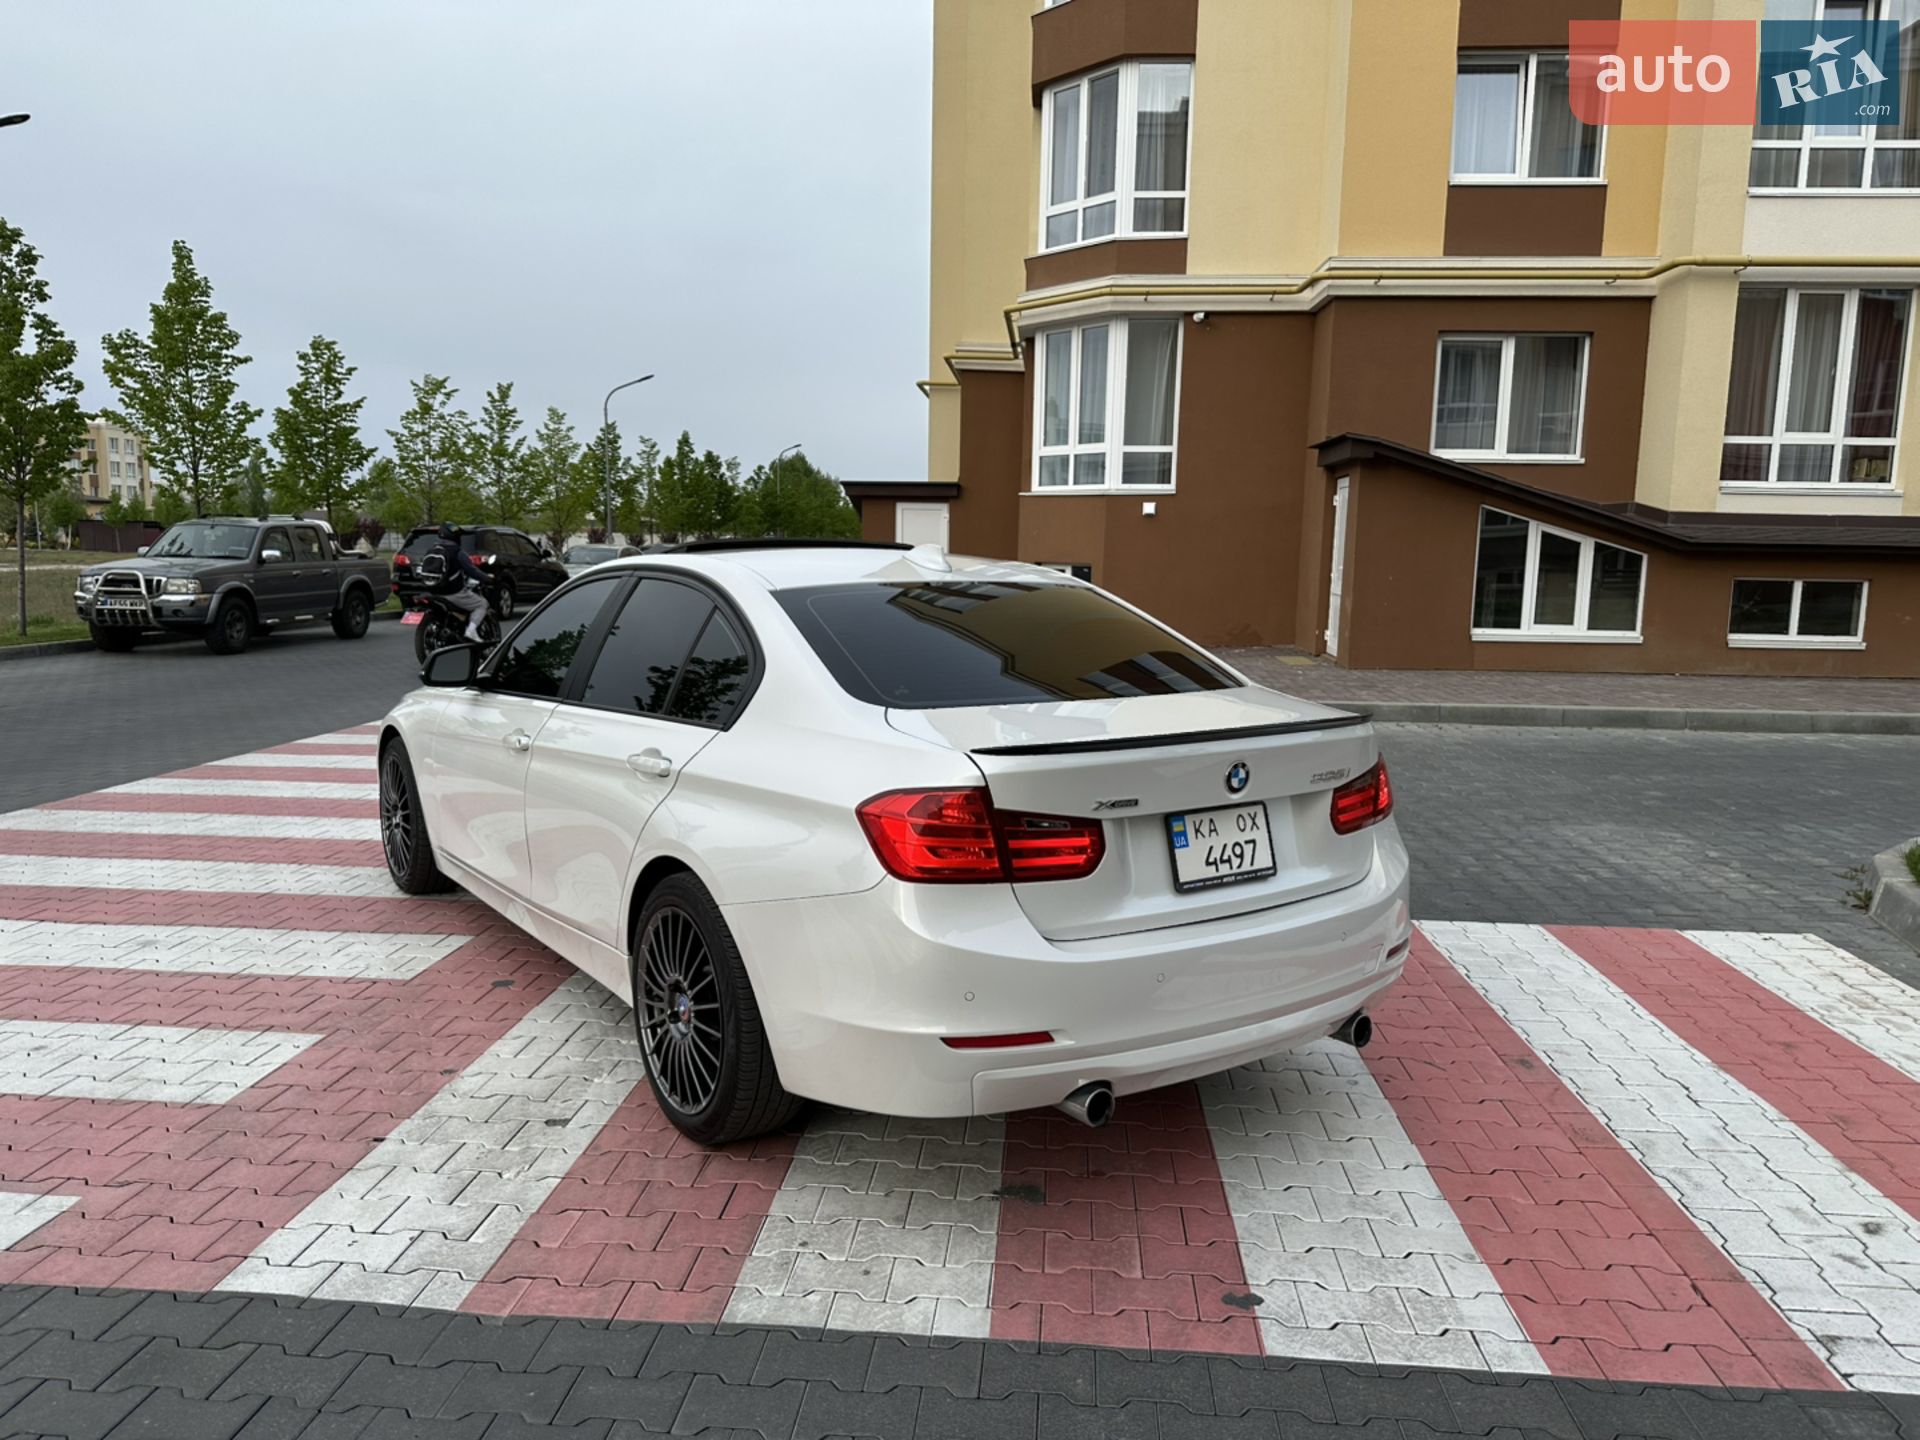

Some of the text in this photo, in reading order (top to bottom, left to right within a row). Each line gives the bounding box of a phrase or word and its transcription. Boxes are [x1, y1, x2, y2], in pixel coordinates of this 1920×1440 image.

[1193, 811, 1260, 840] KA OX
[1174, 836, 1187, 846] UA
[1205, 838, 1256, 873] 4497
